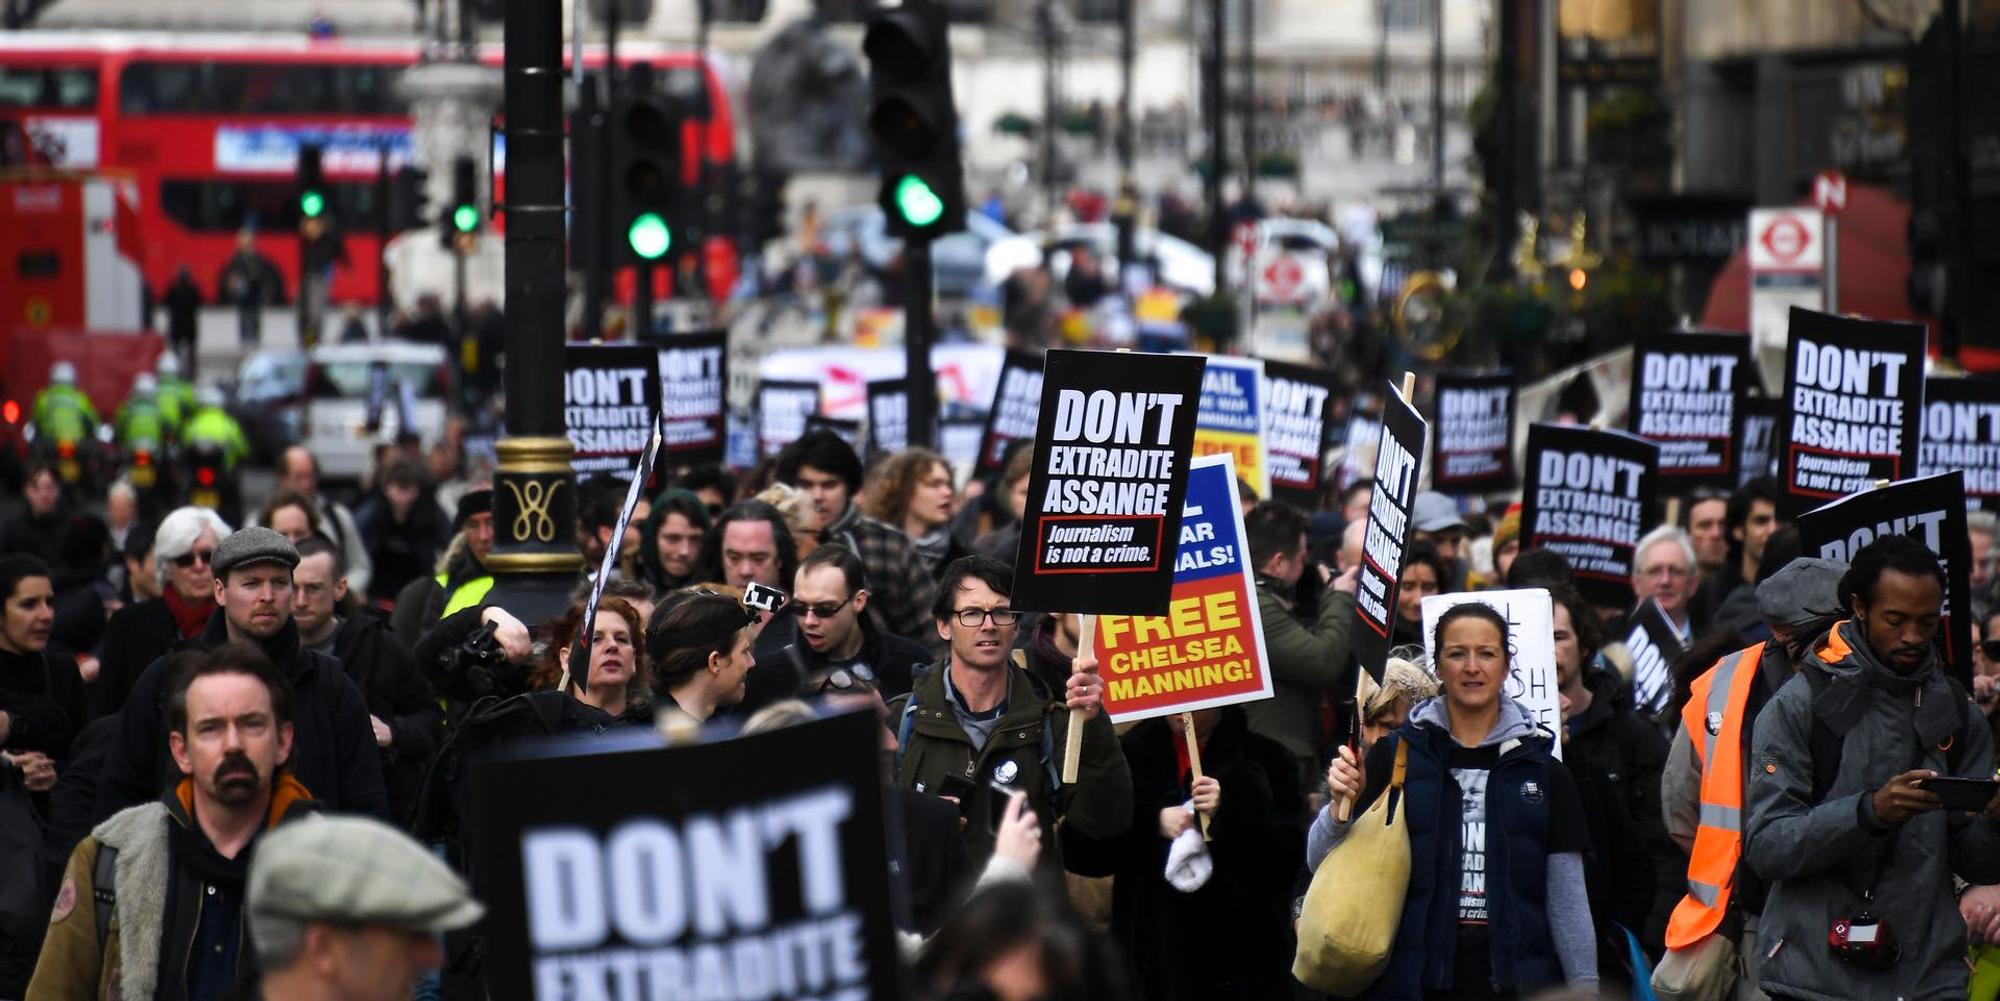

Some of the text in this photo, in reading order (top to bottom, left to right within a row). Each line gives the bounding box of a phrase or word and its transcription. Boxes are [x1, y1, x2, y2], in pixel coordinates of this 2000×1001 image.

[1643, 353, 1738, 391] DON'T
[1795, 338, 1907, 398] DON'T
[1053, 389, 1183, 445] DON'T
[1442, 388, 1510, 417] DON'T
[1641, 391, 1735, 415] EXTRADITE
[1794, 386, 1904, 426] EXTRADITE
[568, 429, 650, 453] SSANGE
[1638, 413, 1733, 436] ASSANGE
[1792, 414, 1902, 457] ASSANGE
[1048, 446, 1174, 479] EXTRADITE
[1376, 424, 1416, 509] DON'T
[1540, 450, 1646, 500] DON'T
[1797, 453, 1870, 476] Journalism
[1042, 479, 1170, 516] ASSANGE
[1809, 474, 1831, 489] not
[1831, 478, 1841, 492] a
[1371, 481, 1407, 545] EXTRADITE
[1537, 488, 1641, 522] EXTRADITE
[1047, 524, 1134, 543] Journalism
[1179, 522, 1215, 545] AR
[1535, 511, 1640, 545] ASSANGE
[1045, 544, 1151, 563] is not a crime.
[1365, 516, 1401, 583] ASSANGE
[1101, 591, 1241, 649] FREE
[1110, 635, 1243, 674] CHELSEA
[1109, 659, 1253, 701] MANNING!
[521, 786, 856, 952] DON'T
[531, 911, 868, 1001] EXTRADITE
